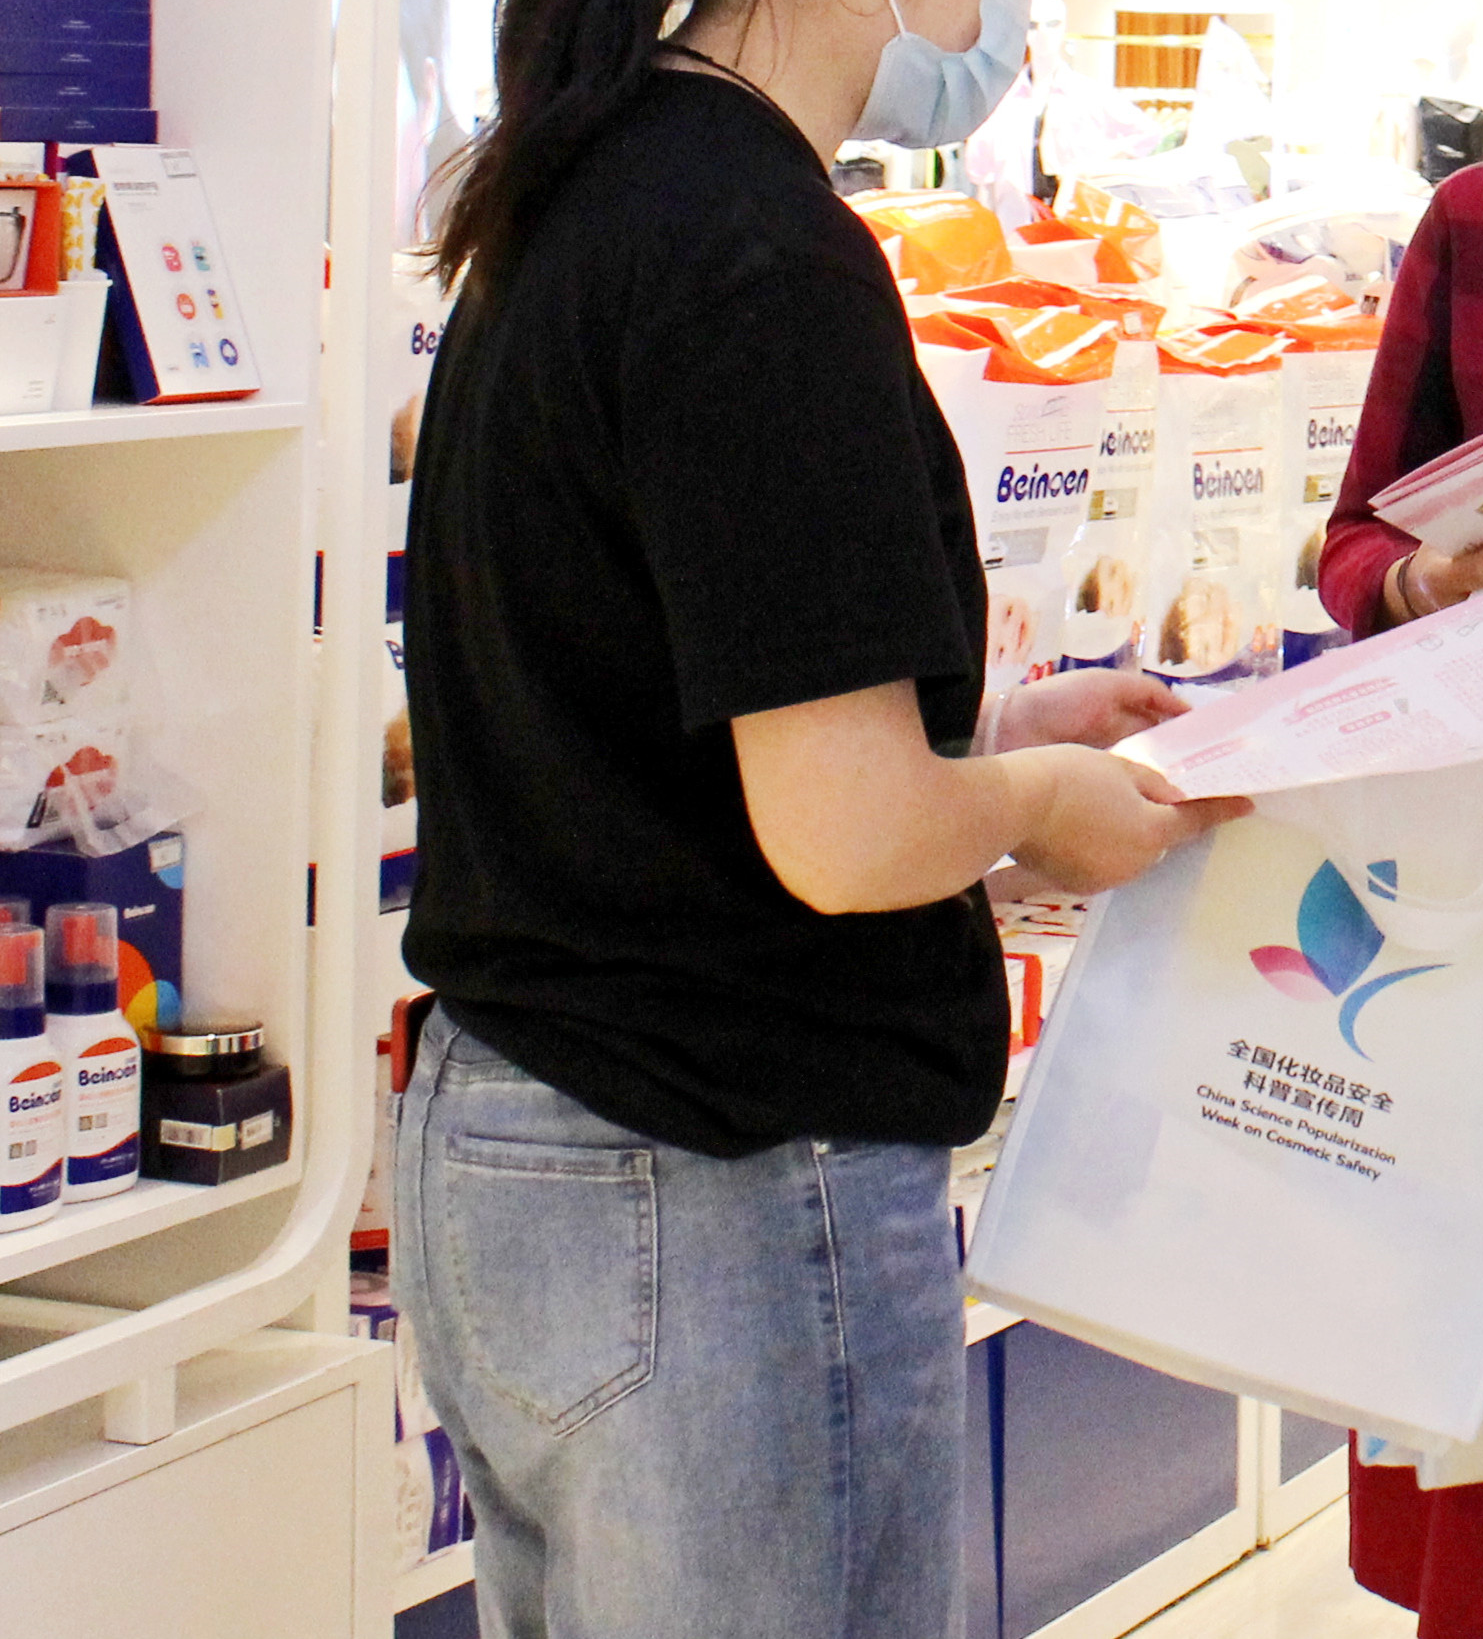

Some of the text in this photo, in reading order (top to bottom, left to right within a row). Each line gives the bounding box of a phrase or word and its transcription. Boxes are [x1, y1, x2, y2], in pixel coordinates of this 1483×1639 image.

[1227, 1038, 1394, 1114] 全国化妆品安全
[1243, 1070, 1364, 1128] 科普宣传周
[1196, 1084, 1397, 1166] China Science Popularization
[1201, 1105, 1382, 1182] Week on Cosmetic Safety
